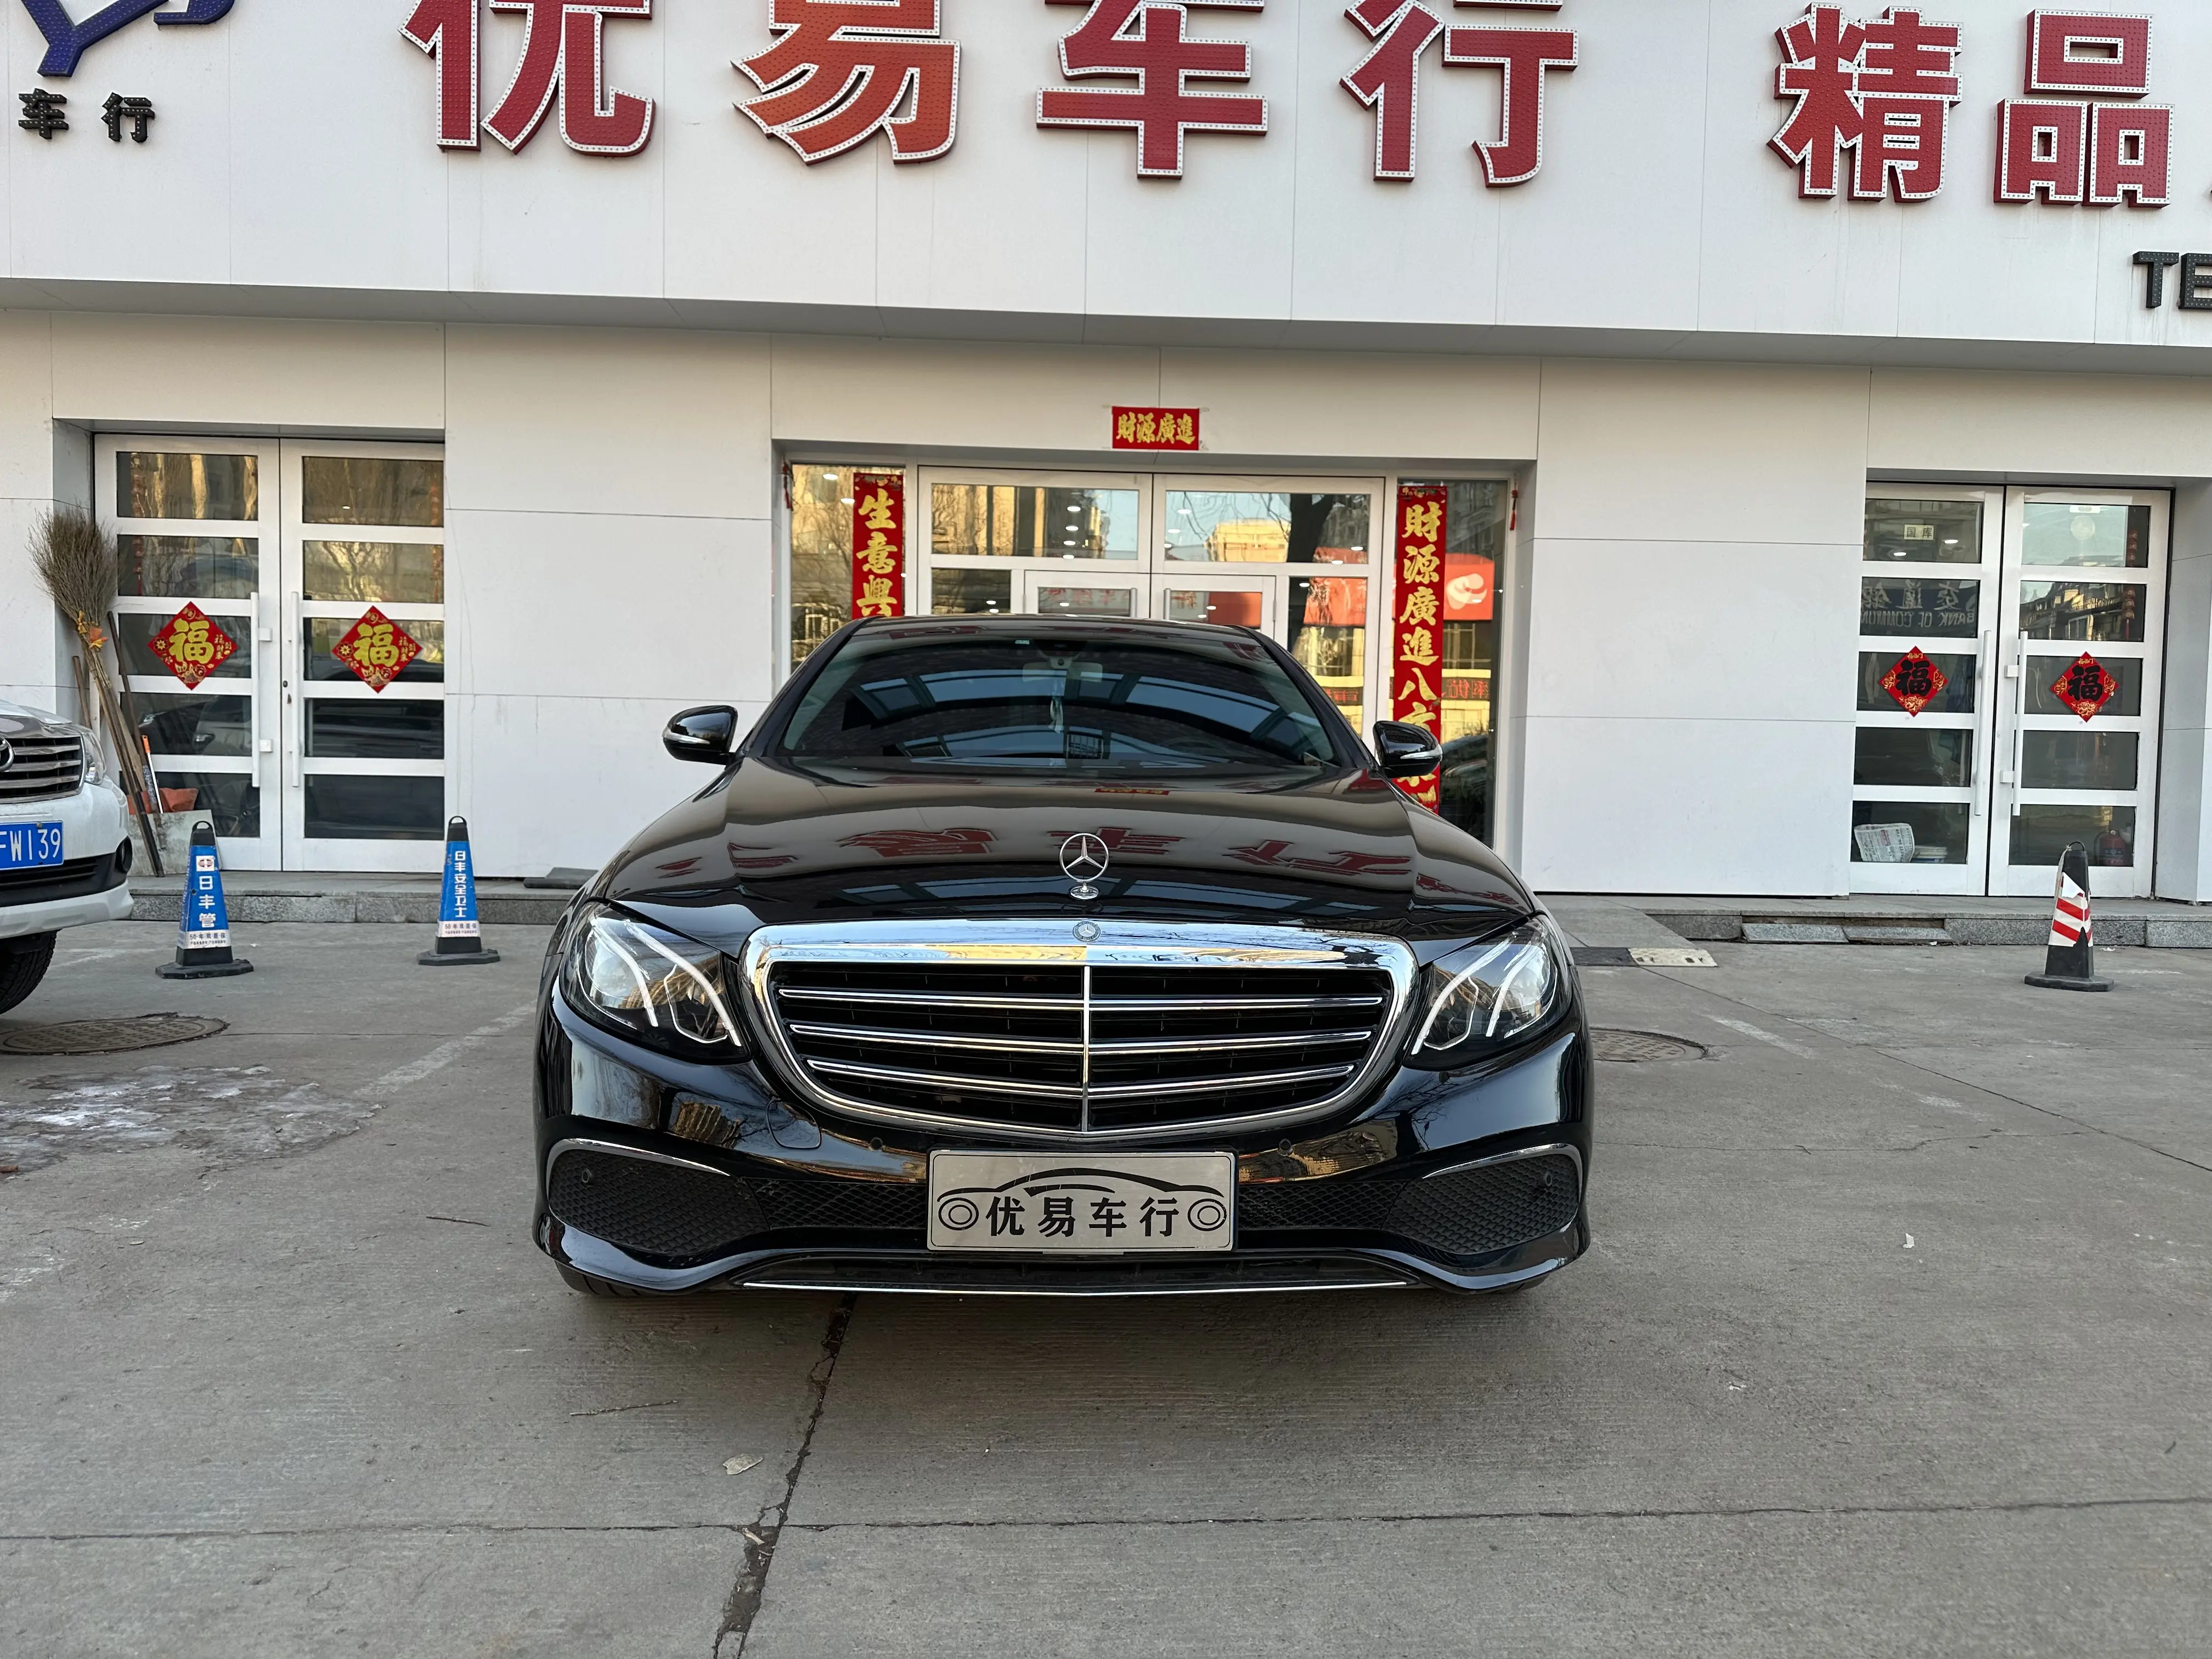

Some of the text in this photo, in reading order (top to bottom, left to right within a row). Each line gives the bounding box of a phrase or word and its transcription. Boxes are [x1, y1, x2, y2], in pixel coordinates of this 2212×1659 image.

[18, 88, 155, 143] 车行
[398, 0, 2175, 208] 优易车行 精品
[1116, 411, 1195, 445] 財源廣進
[169, 618, 215, 664] 福
[354, 623, 399, 669] 福
[1397, 501, 1441, 787] 財源廣進八方
[1896, 659, 1932, 697] 福
[2068, 664, 2104, 702] 福
[198, 876, 216, 928] 日丰管
[454, 850, 467, 918] 日丰安全卫士
[985, 1195, 1180, 1238] 优易车行
